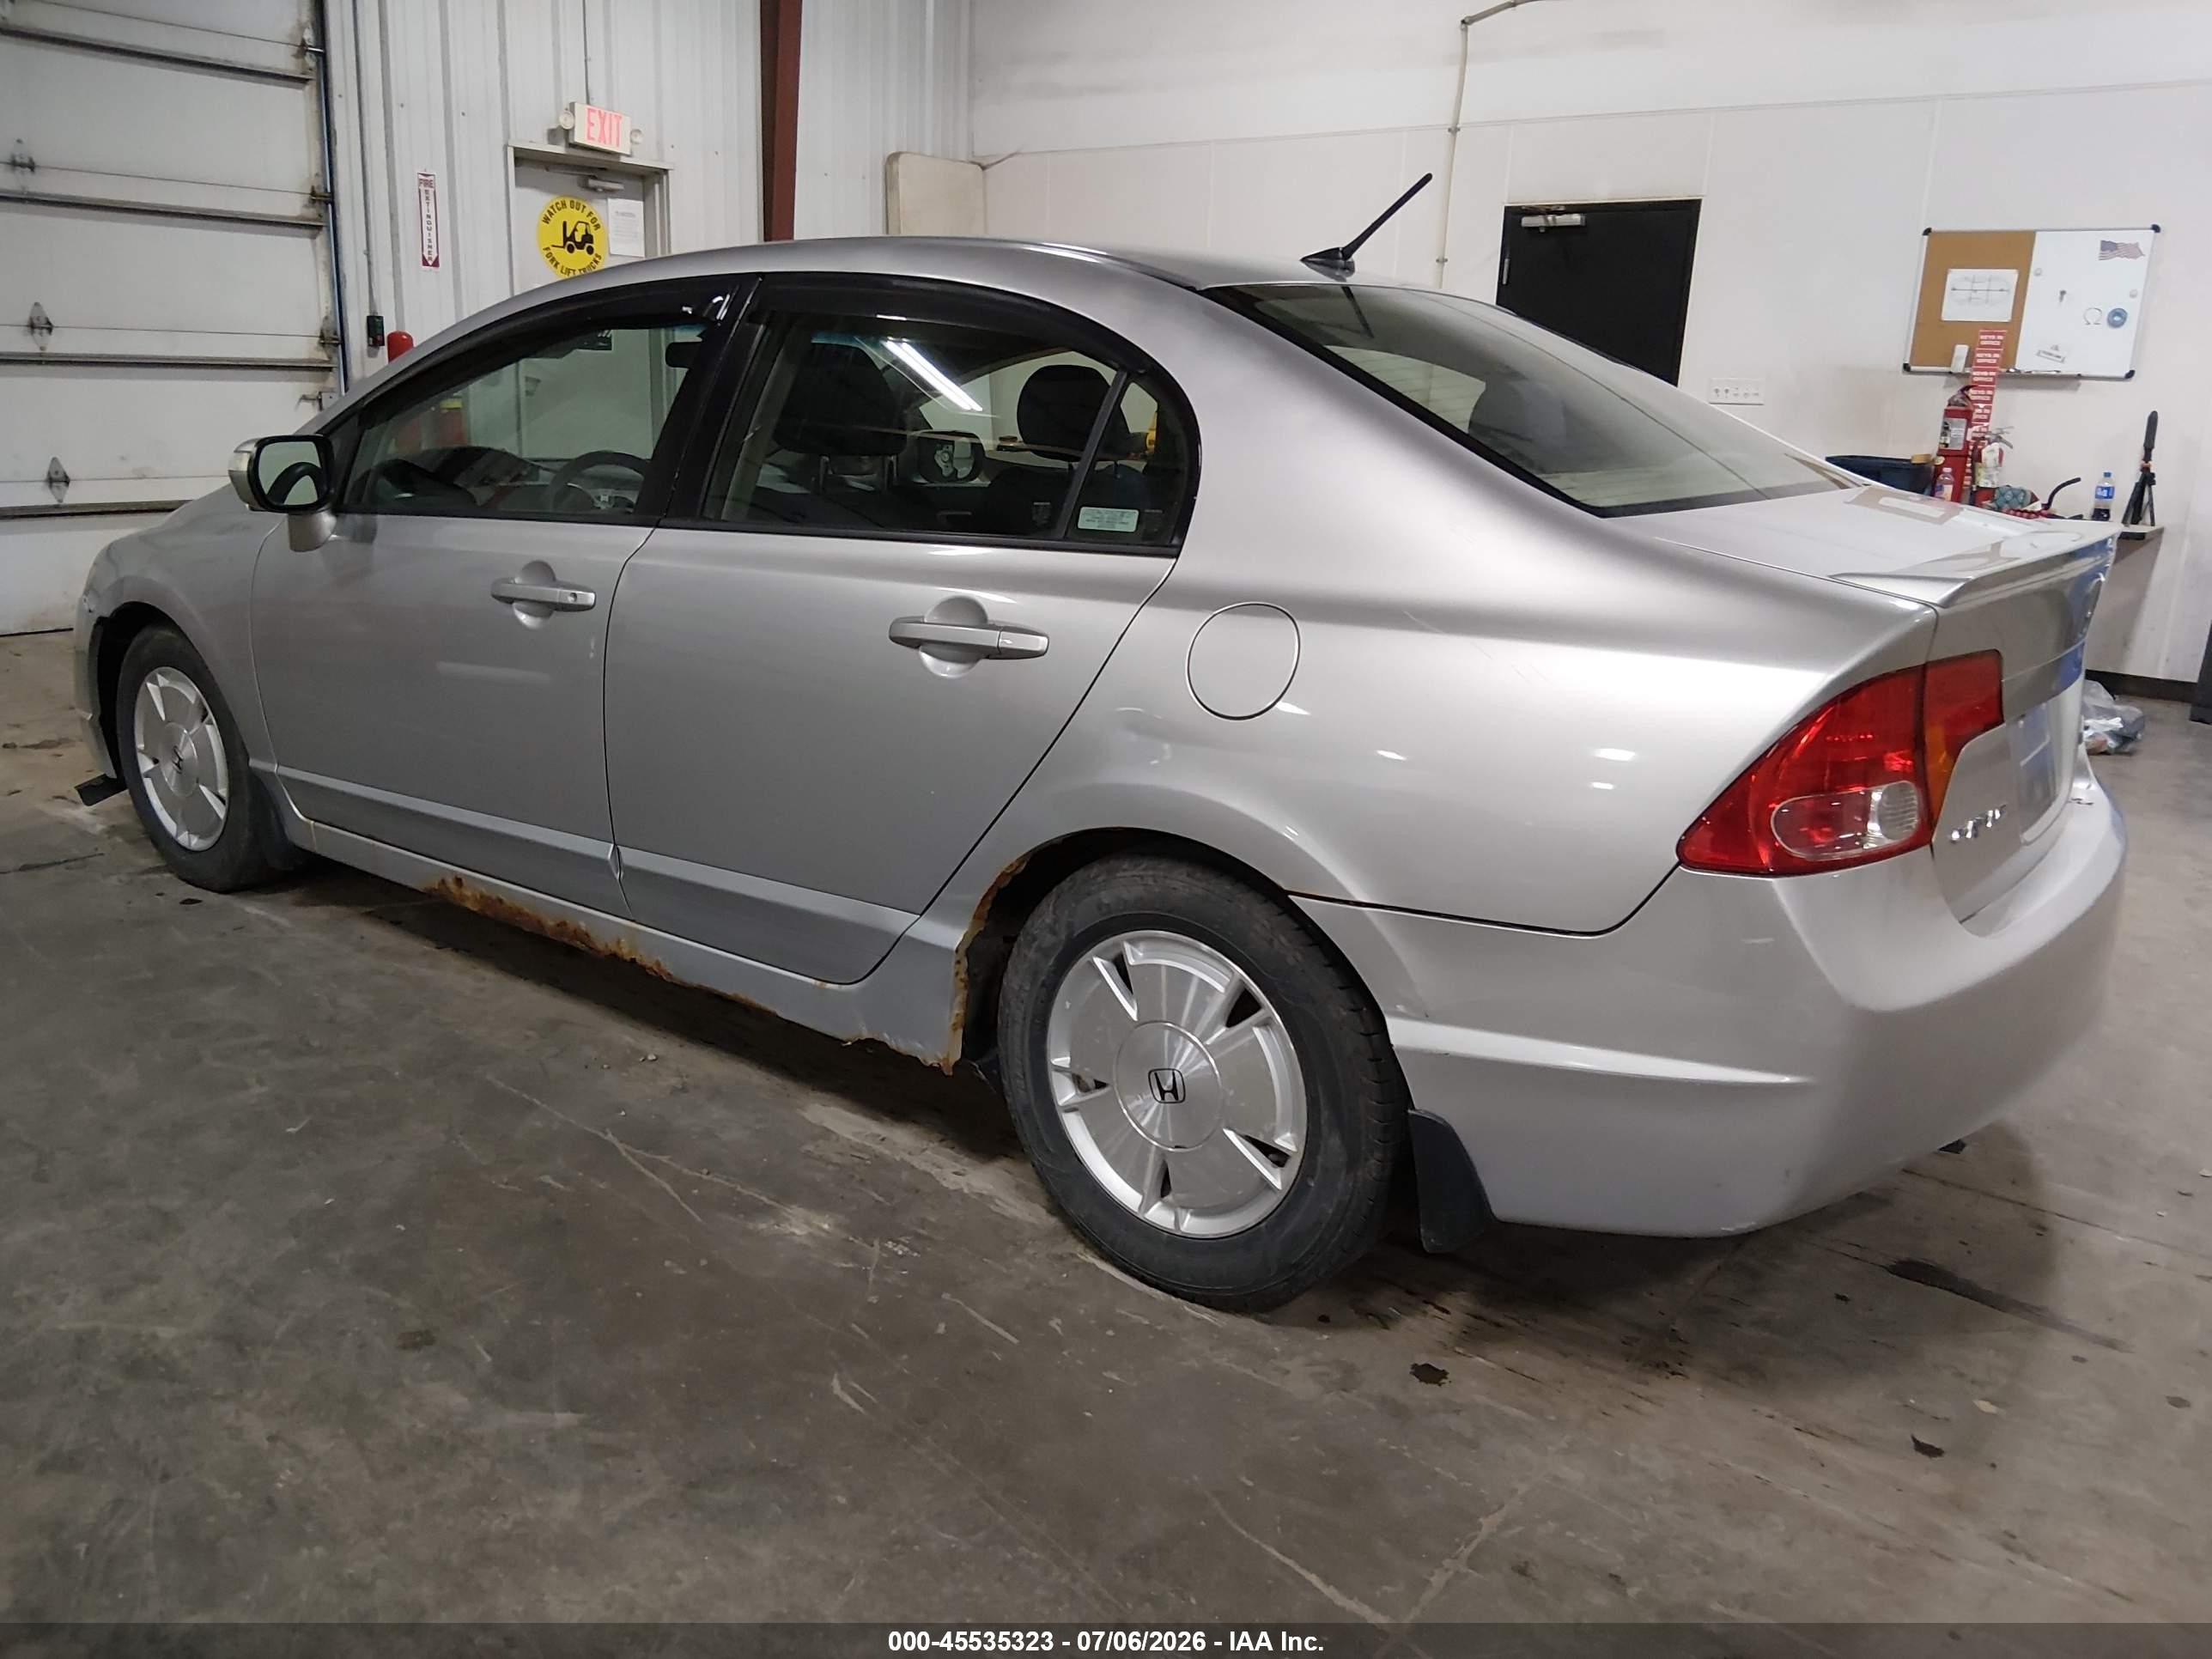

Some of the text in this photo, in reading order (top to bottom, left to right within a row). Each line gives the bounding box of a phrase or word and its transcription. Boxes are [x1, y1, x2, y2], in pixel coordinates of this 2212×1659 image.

[586, 108, 622, 148] EXIT
[418, 178, 434, 188] FIRE
[424, 189, 433, 261] EXTINGUISHER
[542, 200, 567, 225] WATCH
[569, 200, 586, 213] OUT
[586, 211, 601, 231] FOR
[543, 246, 560, 270] FORK
[560, 265, 576, 276] LIFT
